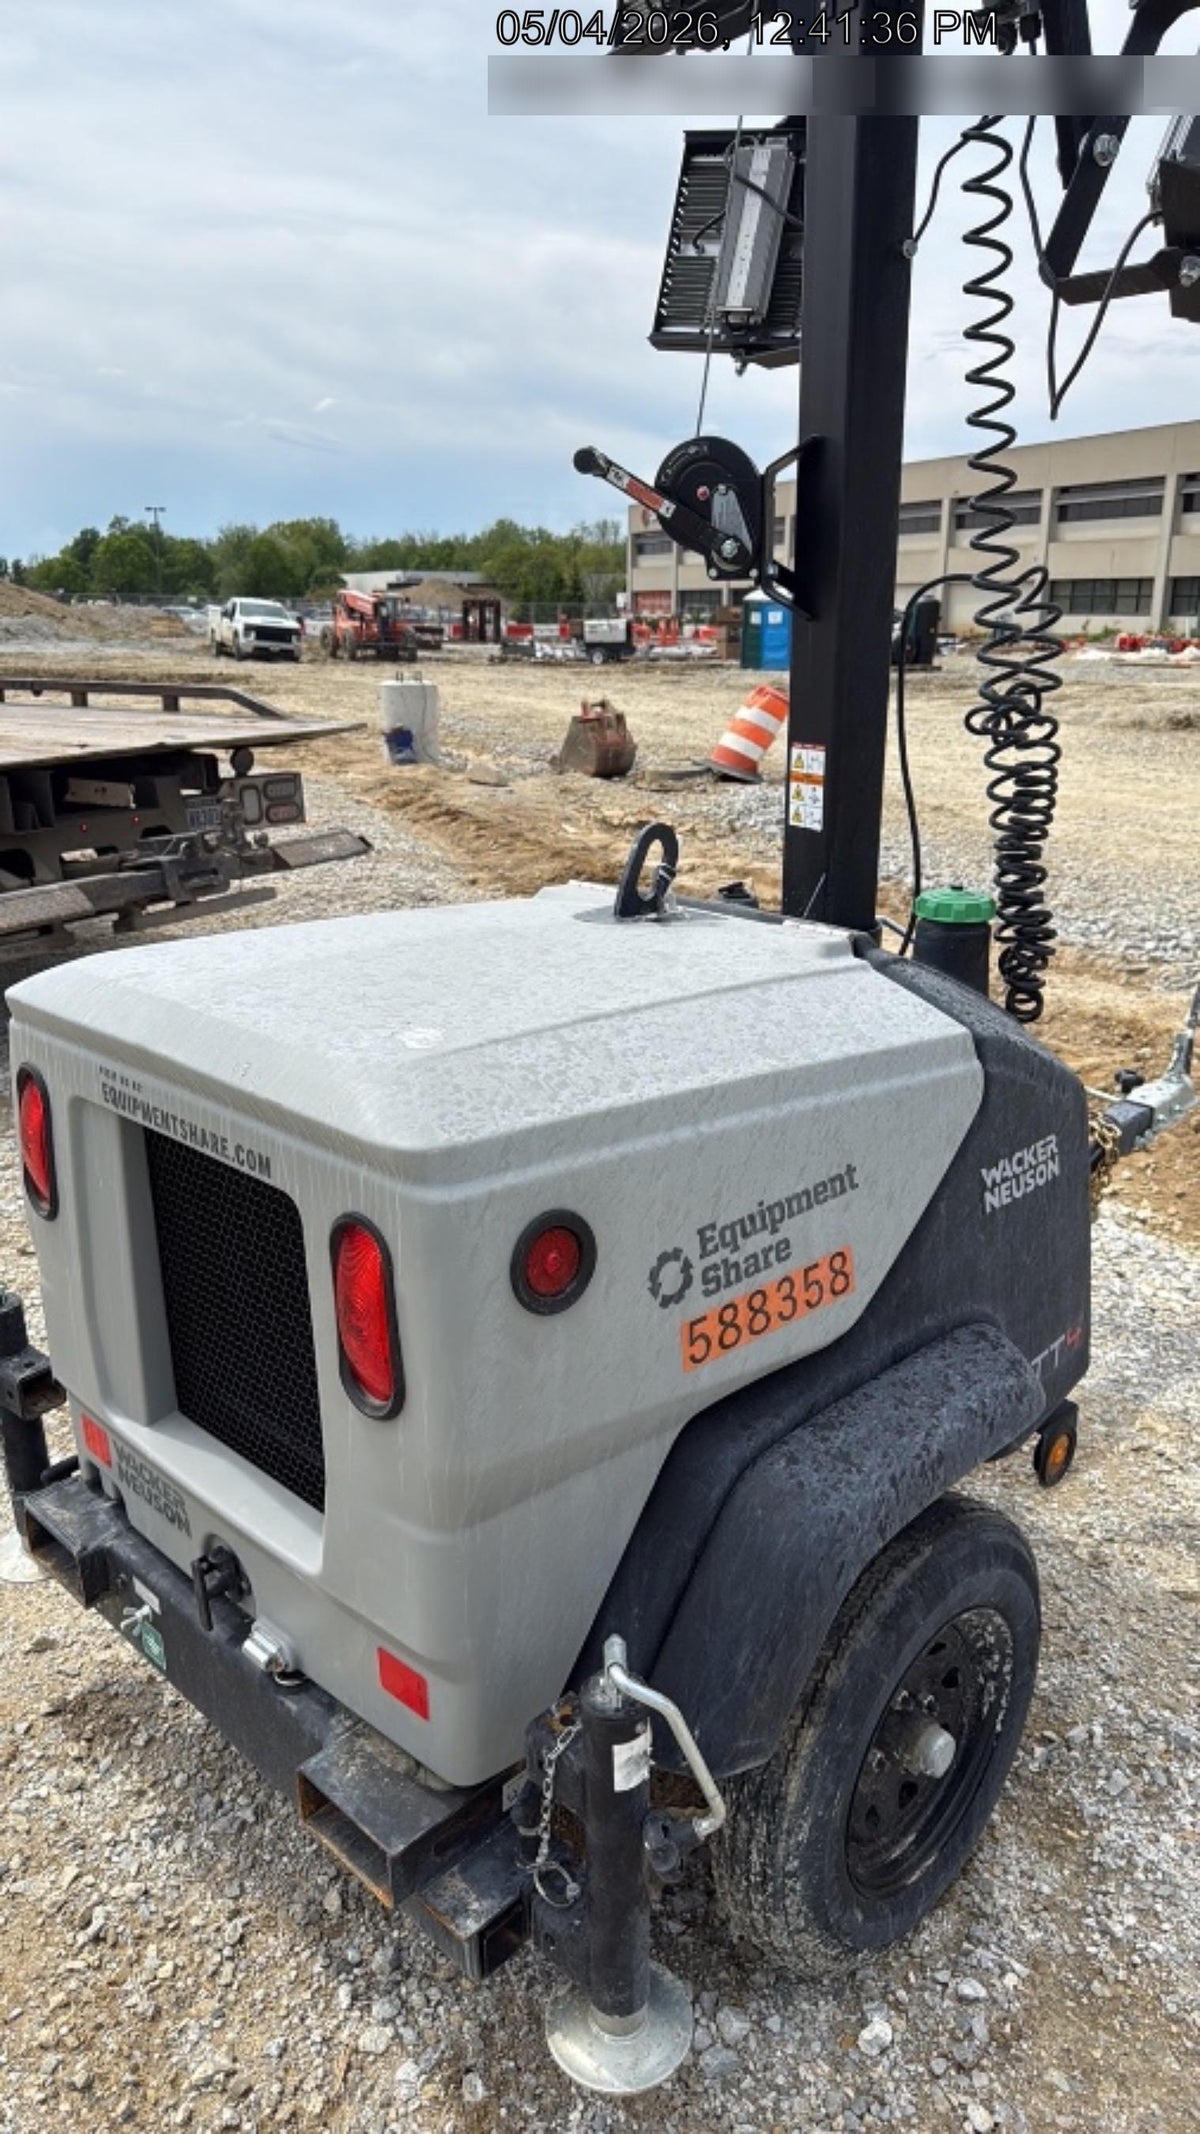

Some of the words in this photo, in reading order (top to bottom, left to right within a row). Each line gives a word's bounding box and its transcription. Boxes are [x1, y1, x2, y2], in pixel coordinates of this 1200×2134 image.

[102, 1081, 272, 1179] EQUIPMENTSHARE.COM
[981, 1134, 1058, 1189] WACKER
[697, 1163, 859, 1260] Equipment
[984, 1154, 1059, 1215] NEUSON
[688, 1250, 851, 1364] 588358
[701, 1237, 792, 1298] Share
